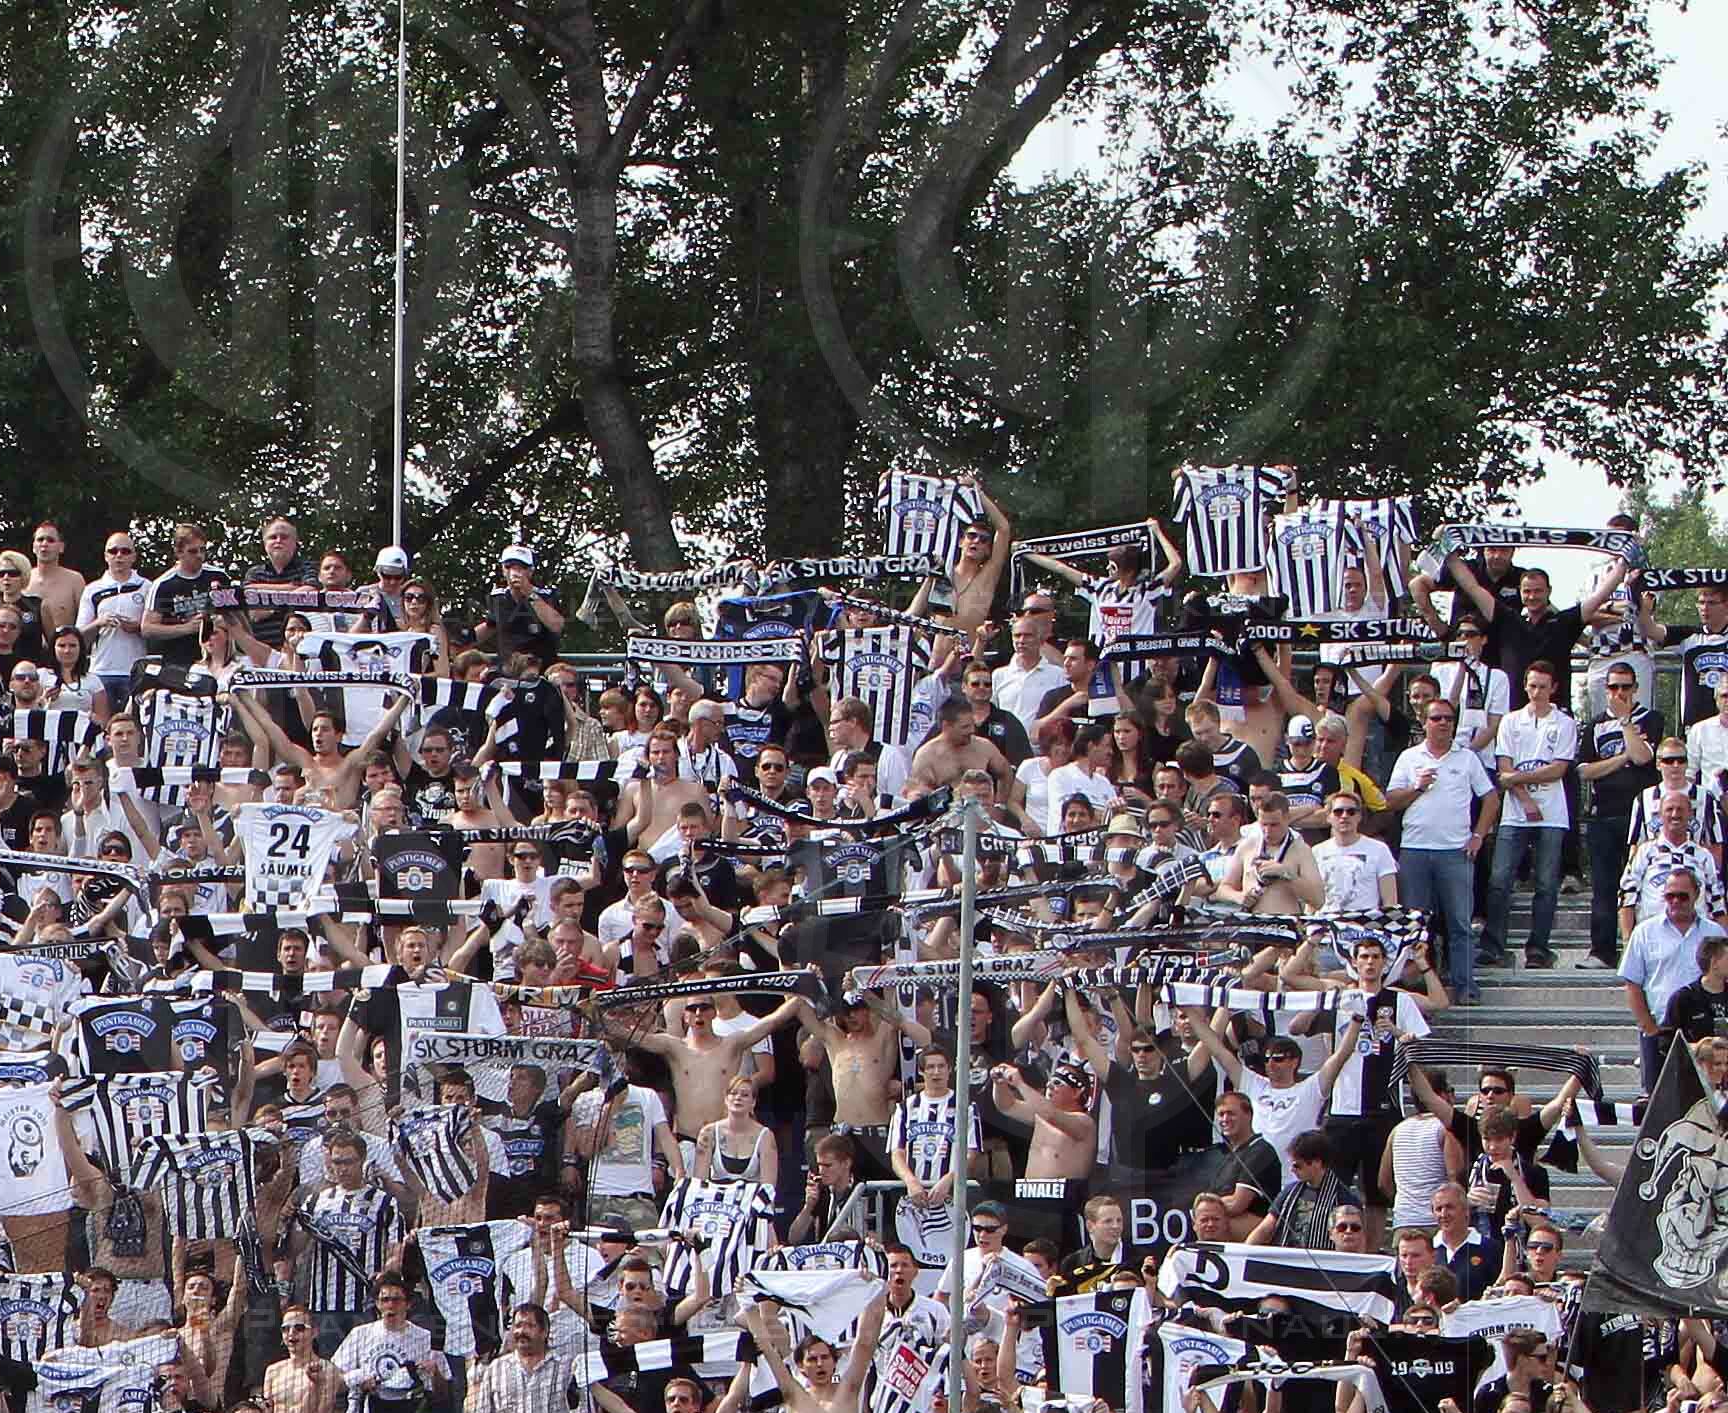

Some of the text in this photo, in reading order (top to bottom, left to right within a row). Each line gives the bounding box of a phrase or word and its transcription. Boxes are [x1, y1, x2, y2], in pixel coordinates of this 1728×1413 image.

[801, 556, 877, 579] STURM
[1645, 570, 1673, 585] SK
[1246, 622, 1362, 641] 2000 SK
[266, 822, 312, 860] 24
[385, 855, 445, 873] PUNTIGAMER
[992, 957, 1036, 973] GRAZ
[92, 1013, 157, 1038] PUNTIGAMER
[415, 1038, 598, 1066] SK STURM GRAZ
[1015, 1183, 1066, 1199] FINALE!
[1060, 1312, 1128, 1337] PUNTIGAMER
